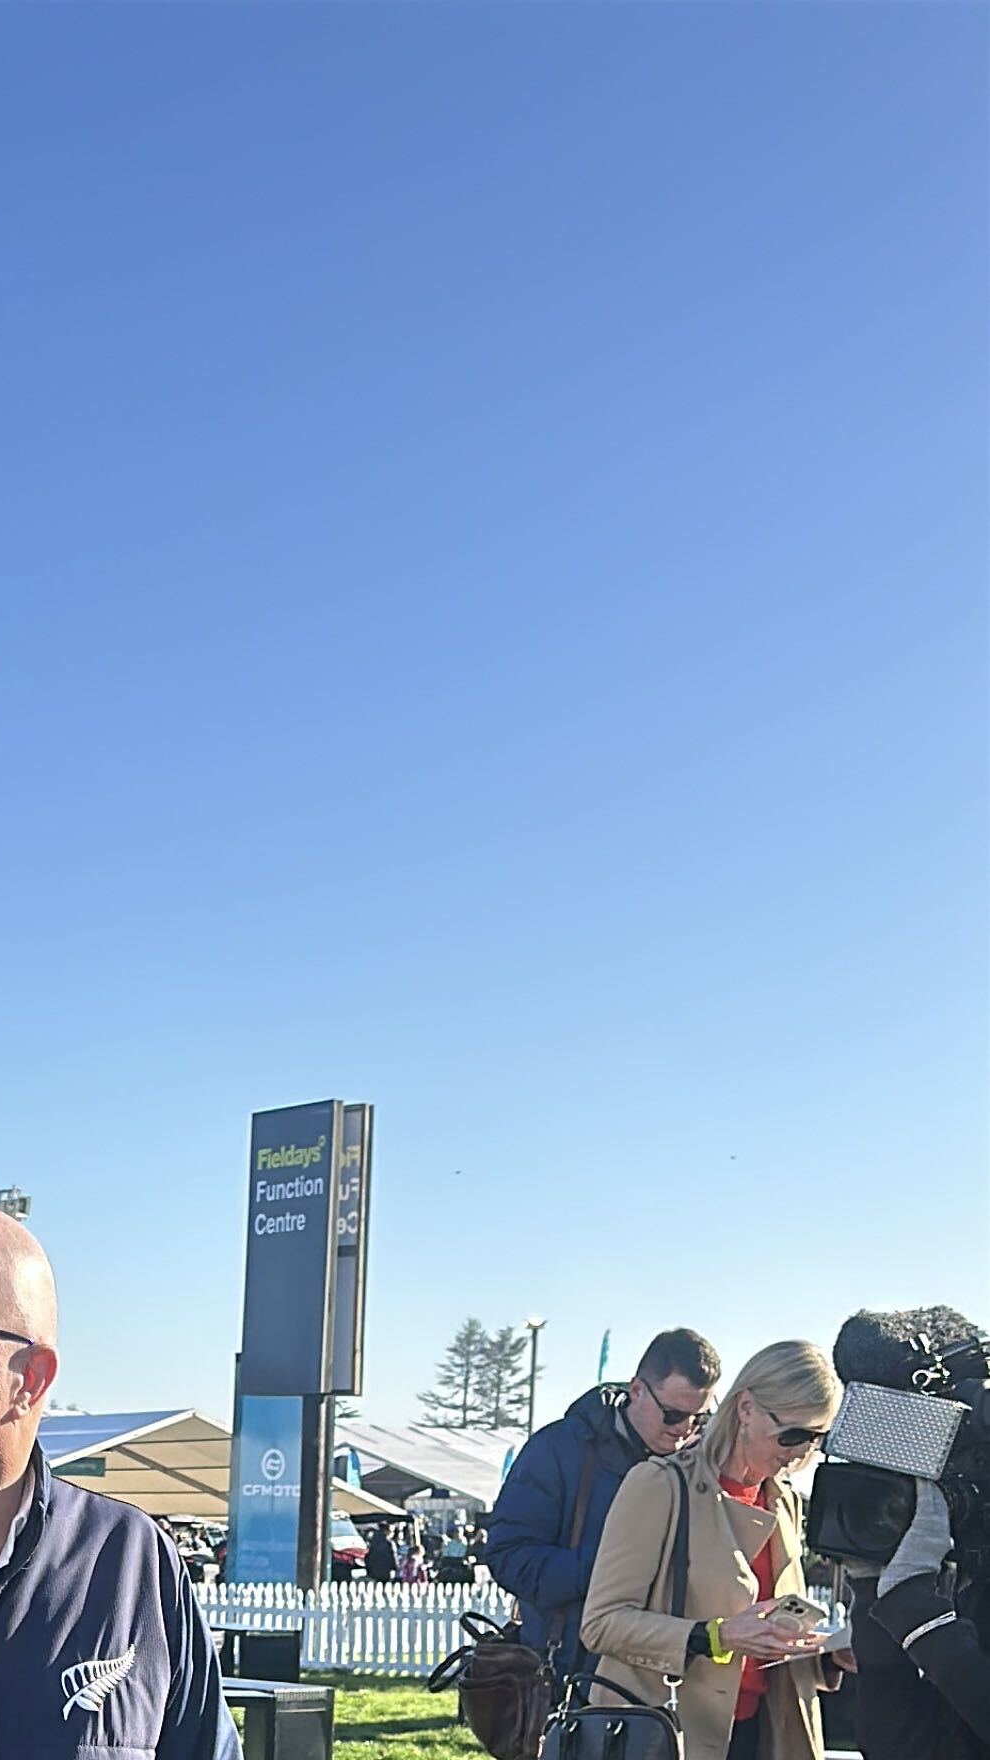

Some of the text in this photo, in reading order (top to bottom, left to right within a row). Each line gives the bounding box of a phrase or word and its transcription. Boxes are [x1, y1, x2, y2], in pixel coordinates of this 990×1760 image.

[256, 1176, 324, 1202] Function
[254, 1212, 306, 1235] Centre
[242, 1484, 301, 1497] CFMOTO
